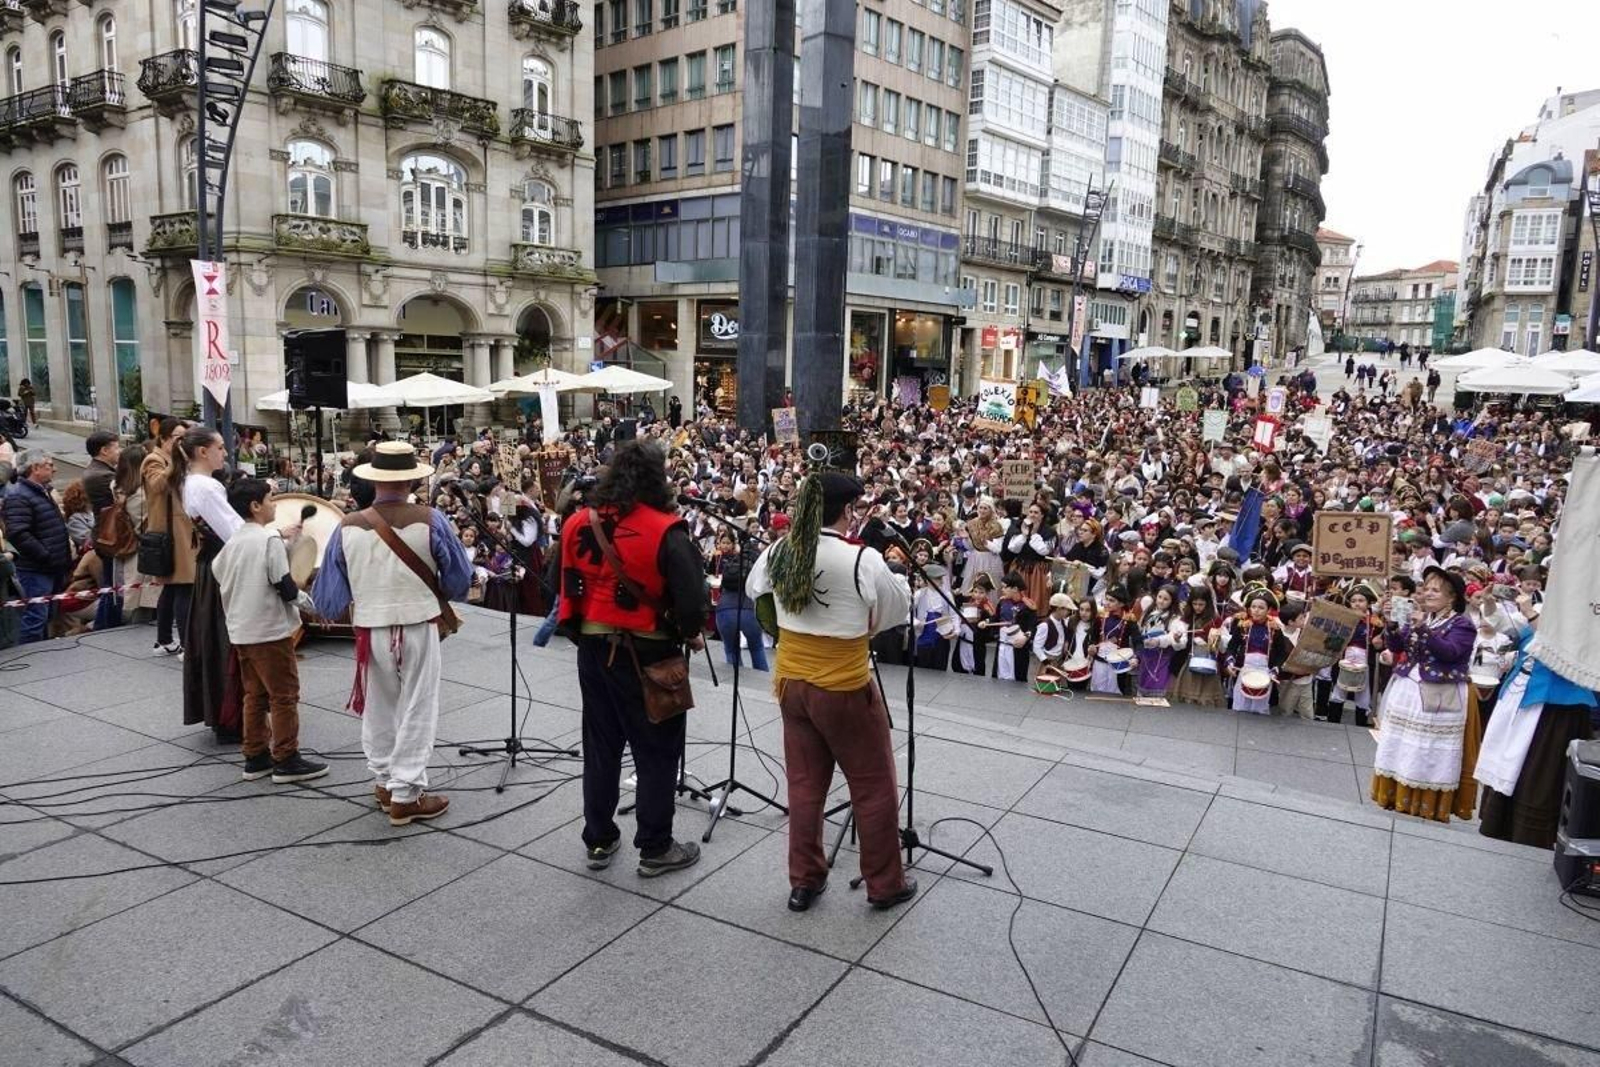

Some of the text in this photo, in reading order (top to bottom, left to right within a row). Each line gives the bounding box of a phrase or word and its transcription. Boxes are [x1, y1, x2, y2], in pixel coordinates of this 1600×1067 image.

[1581, 252, 1591, 287] HOTEL
[206, 320, 227, 361] R
[204, 363, 231, 382] 1809
[980, 386, 1015, 406] COLEXIO
